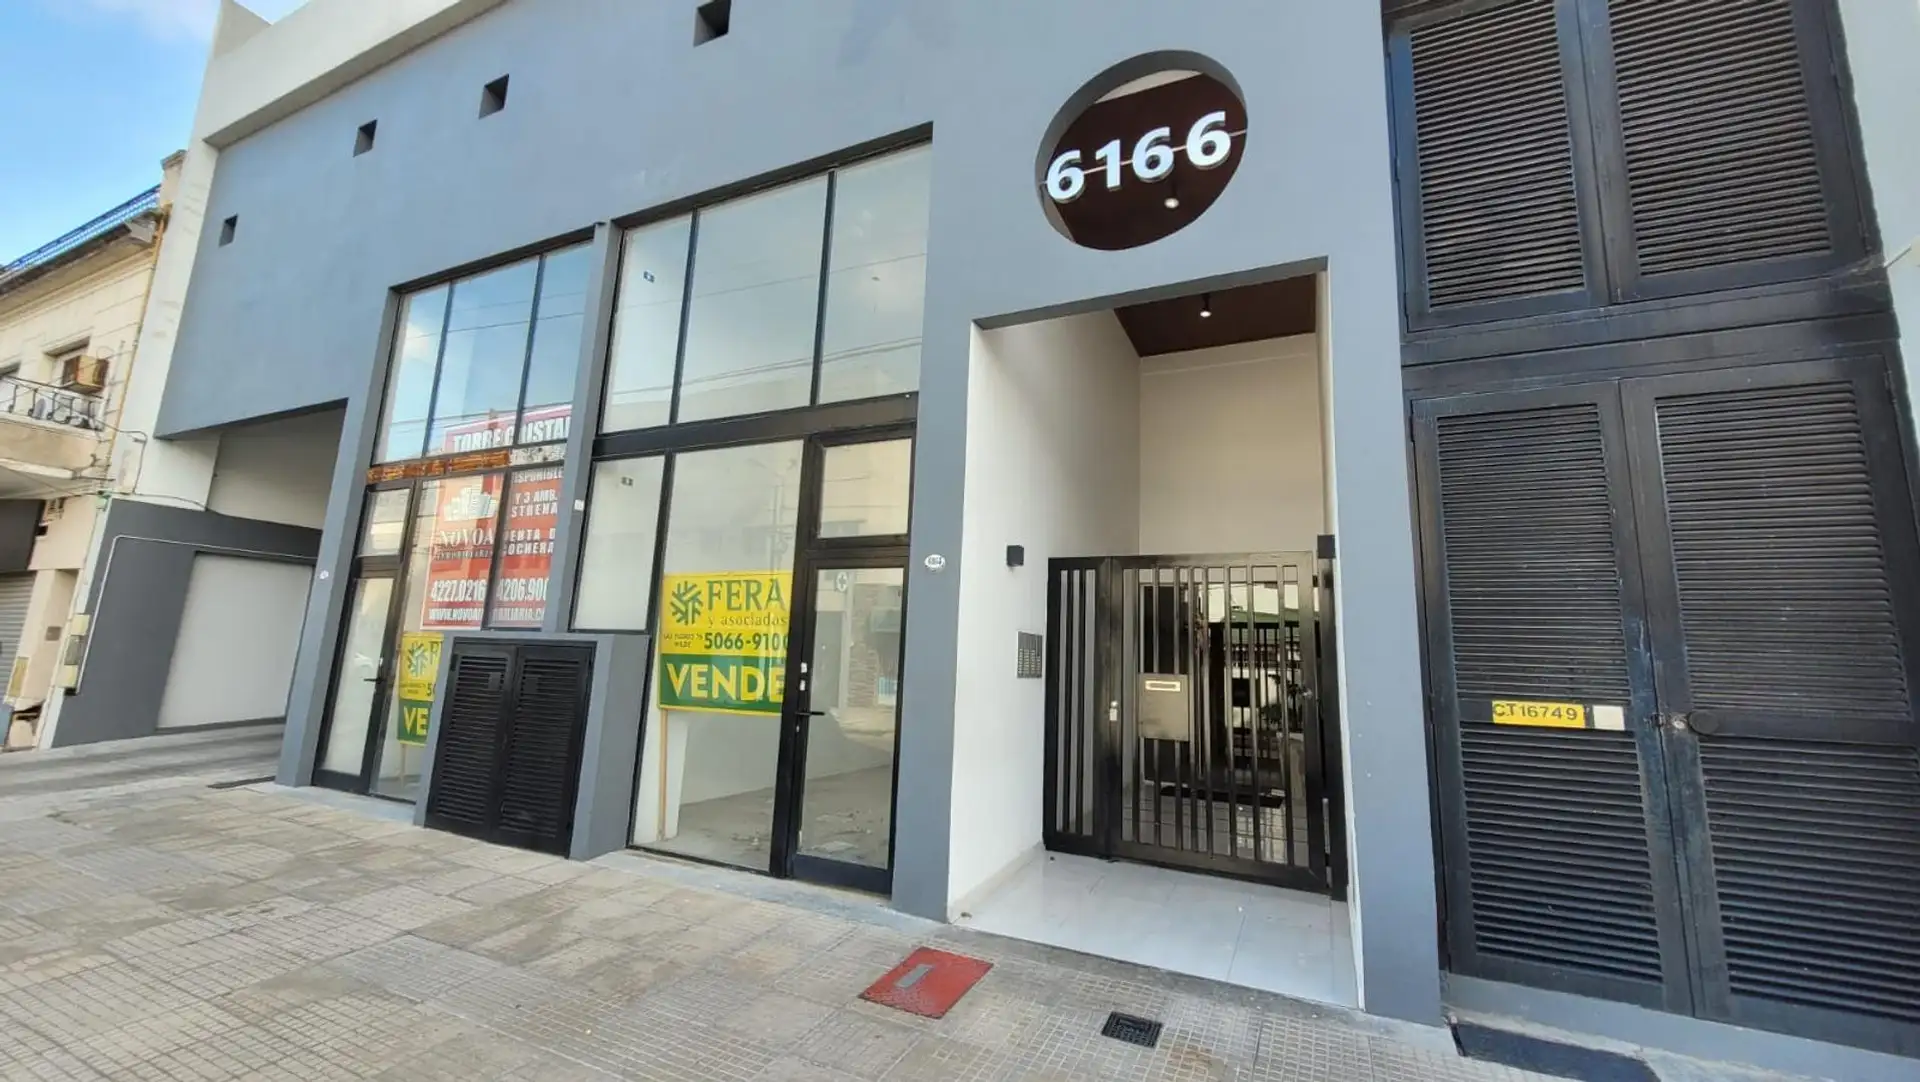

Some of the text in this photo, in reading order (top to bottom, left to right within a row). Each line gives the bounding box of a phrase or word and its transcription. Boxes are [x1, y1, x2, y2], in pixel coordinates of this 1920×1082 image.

[1047, 111, 1232, 203] 6166
[440, 527, 494, 547] NOVOA
[706, 578, 786, 612] FERA
[721, 611, 787, 627] asociados
[666, 663, 785, 703] VENDE
[1493, 703, 1577, 720] CT16749
